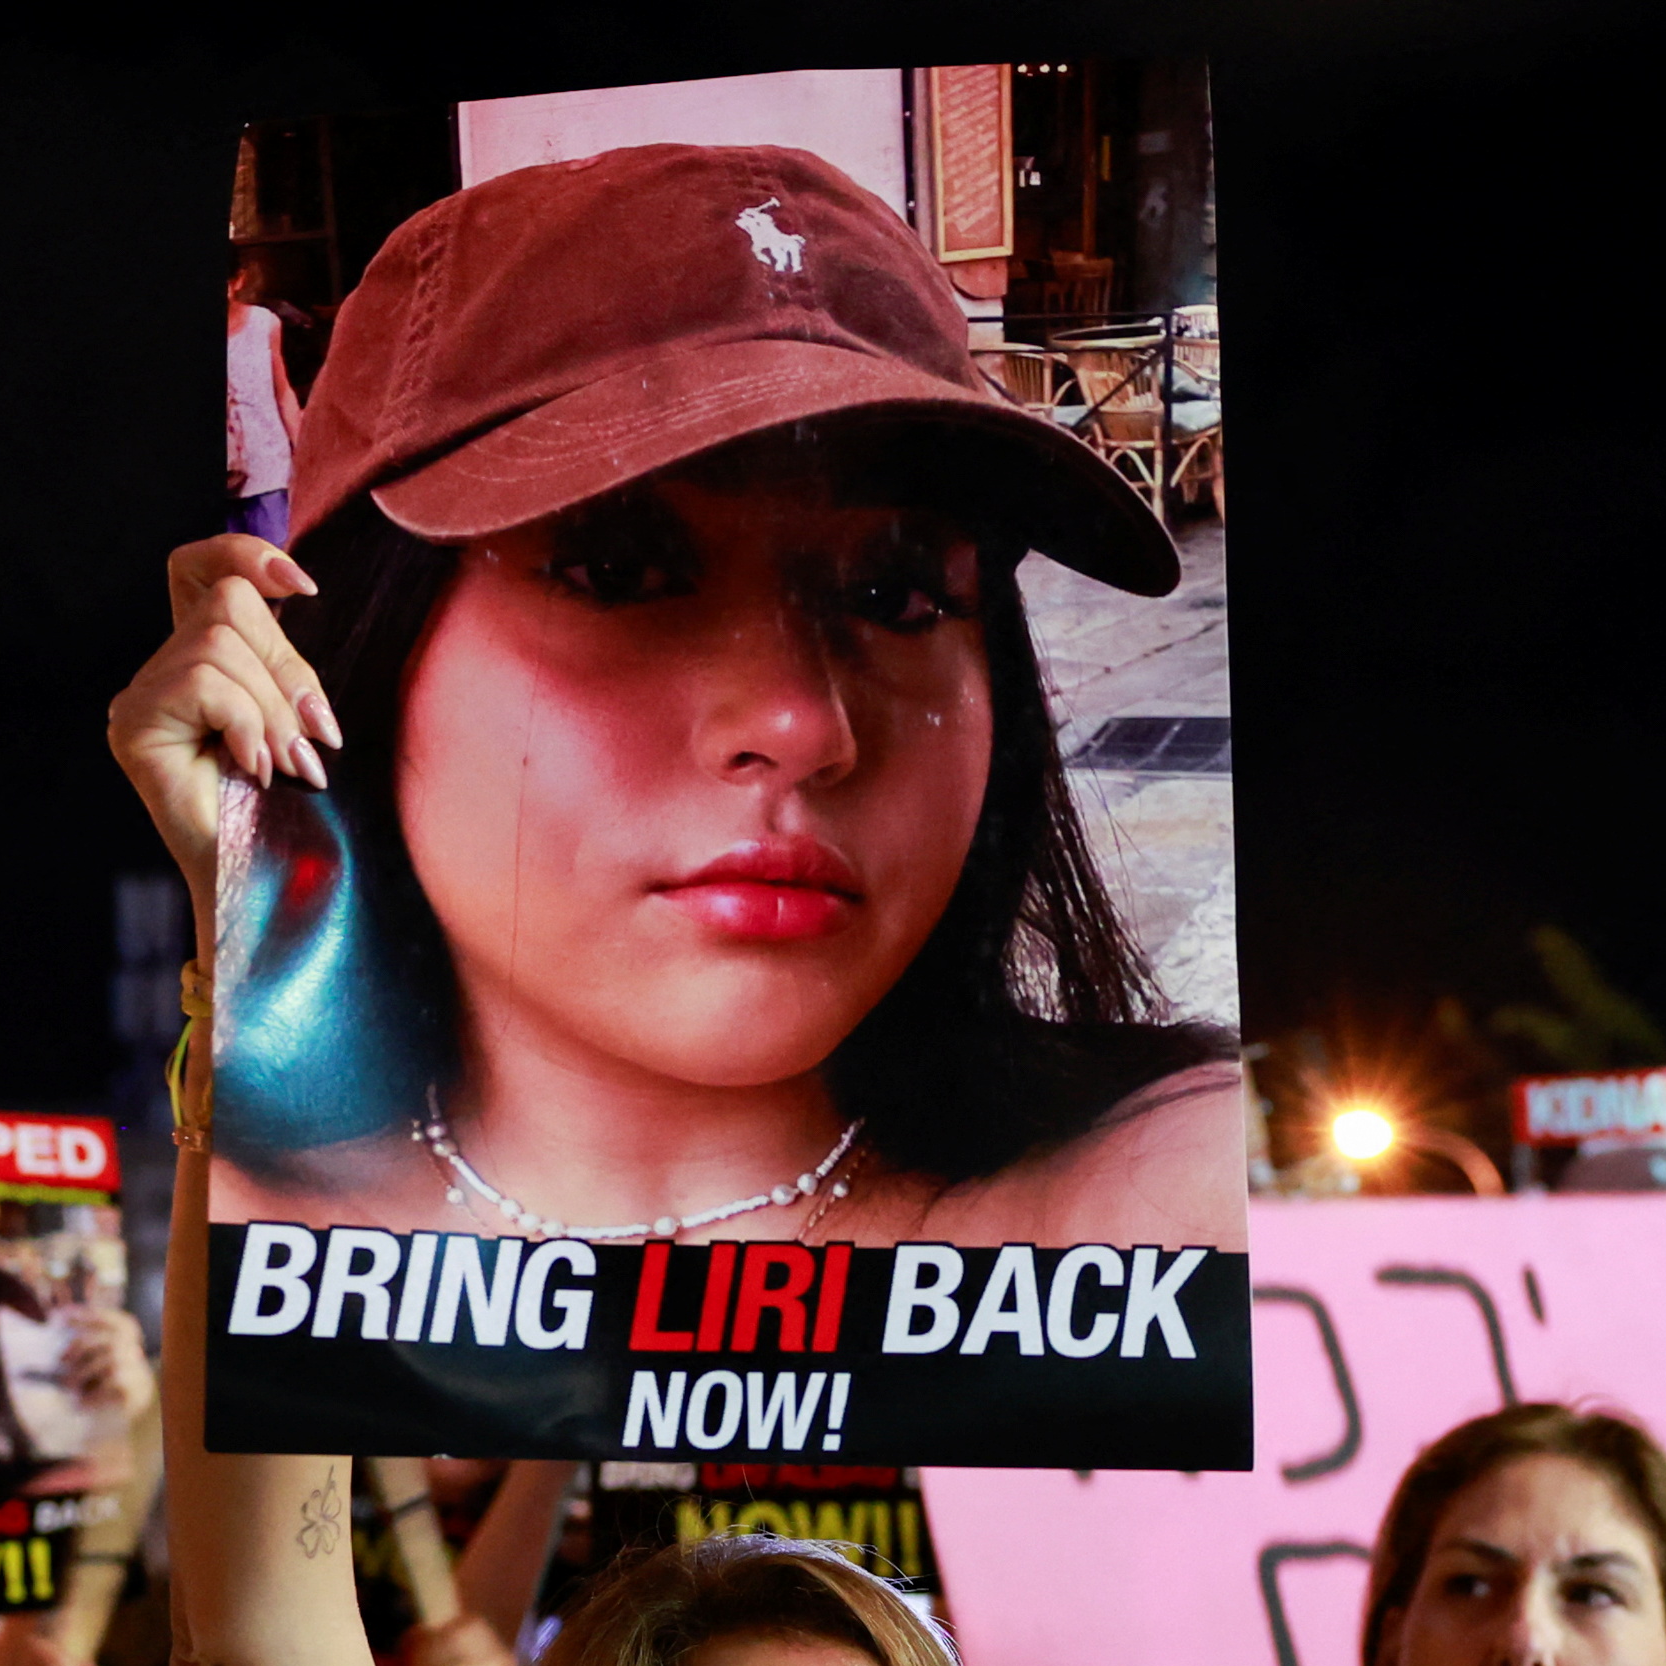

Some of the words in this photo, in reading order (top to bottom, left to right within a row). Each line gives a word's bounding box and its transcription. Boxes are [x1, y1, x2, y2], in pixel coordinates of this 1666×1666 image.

[228, 1225, 597, 1350] BRING
[628, 1242, 851, 1352] LIRI
[882, 1246, 1208, 1358] BACK
[621, 1369, 851, 1451] NOW!
